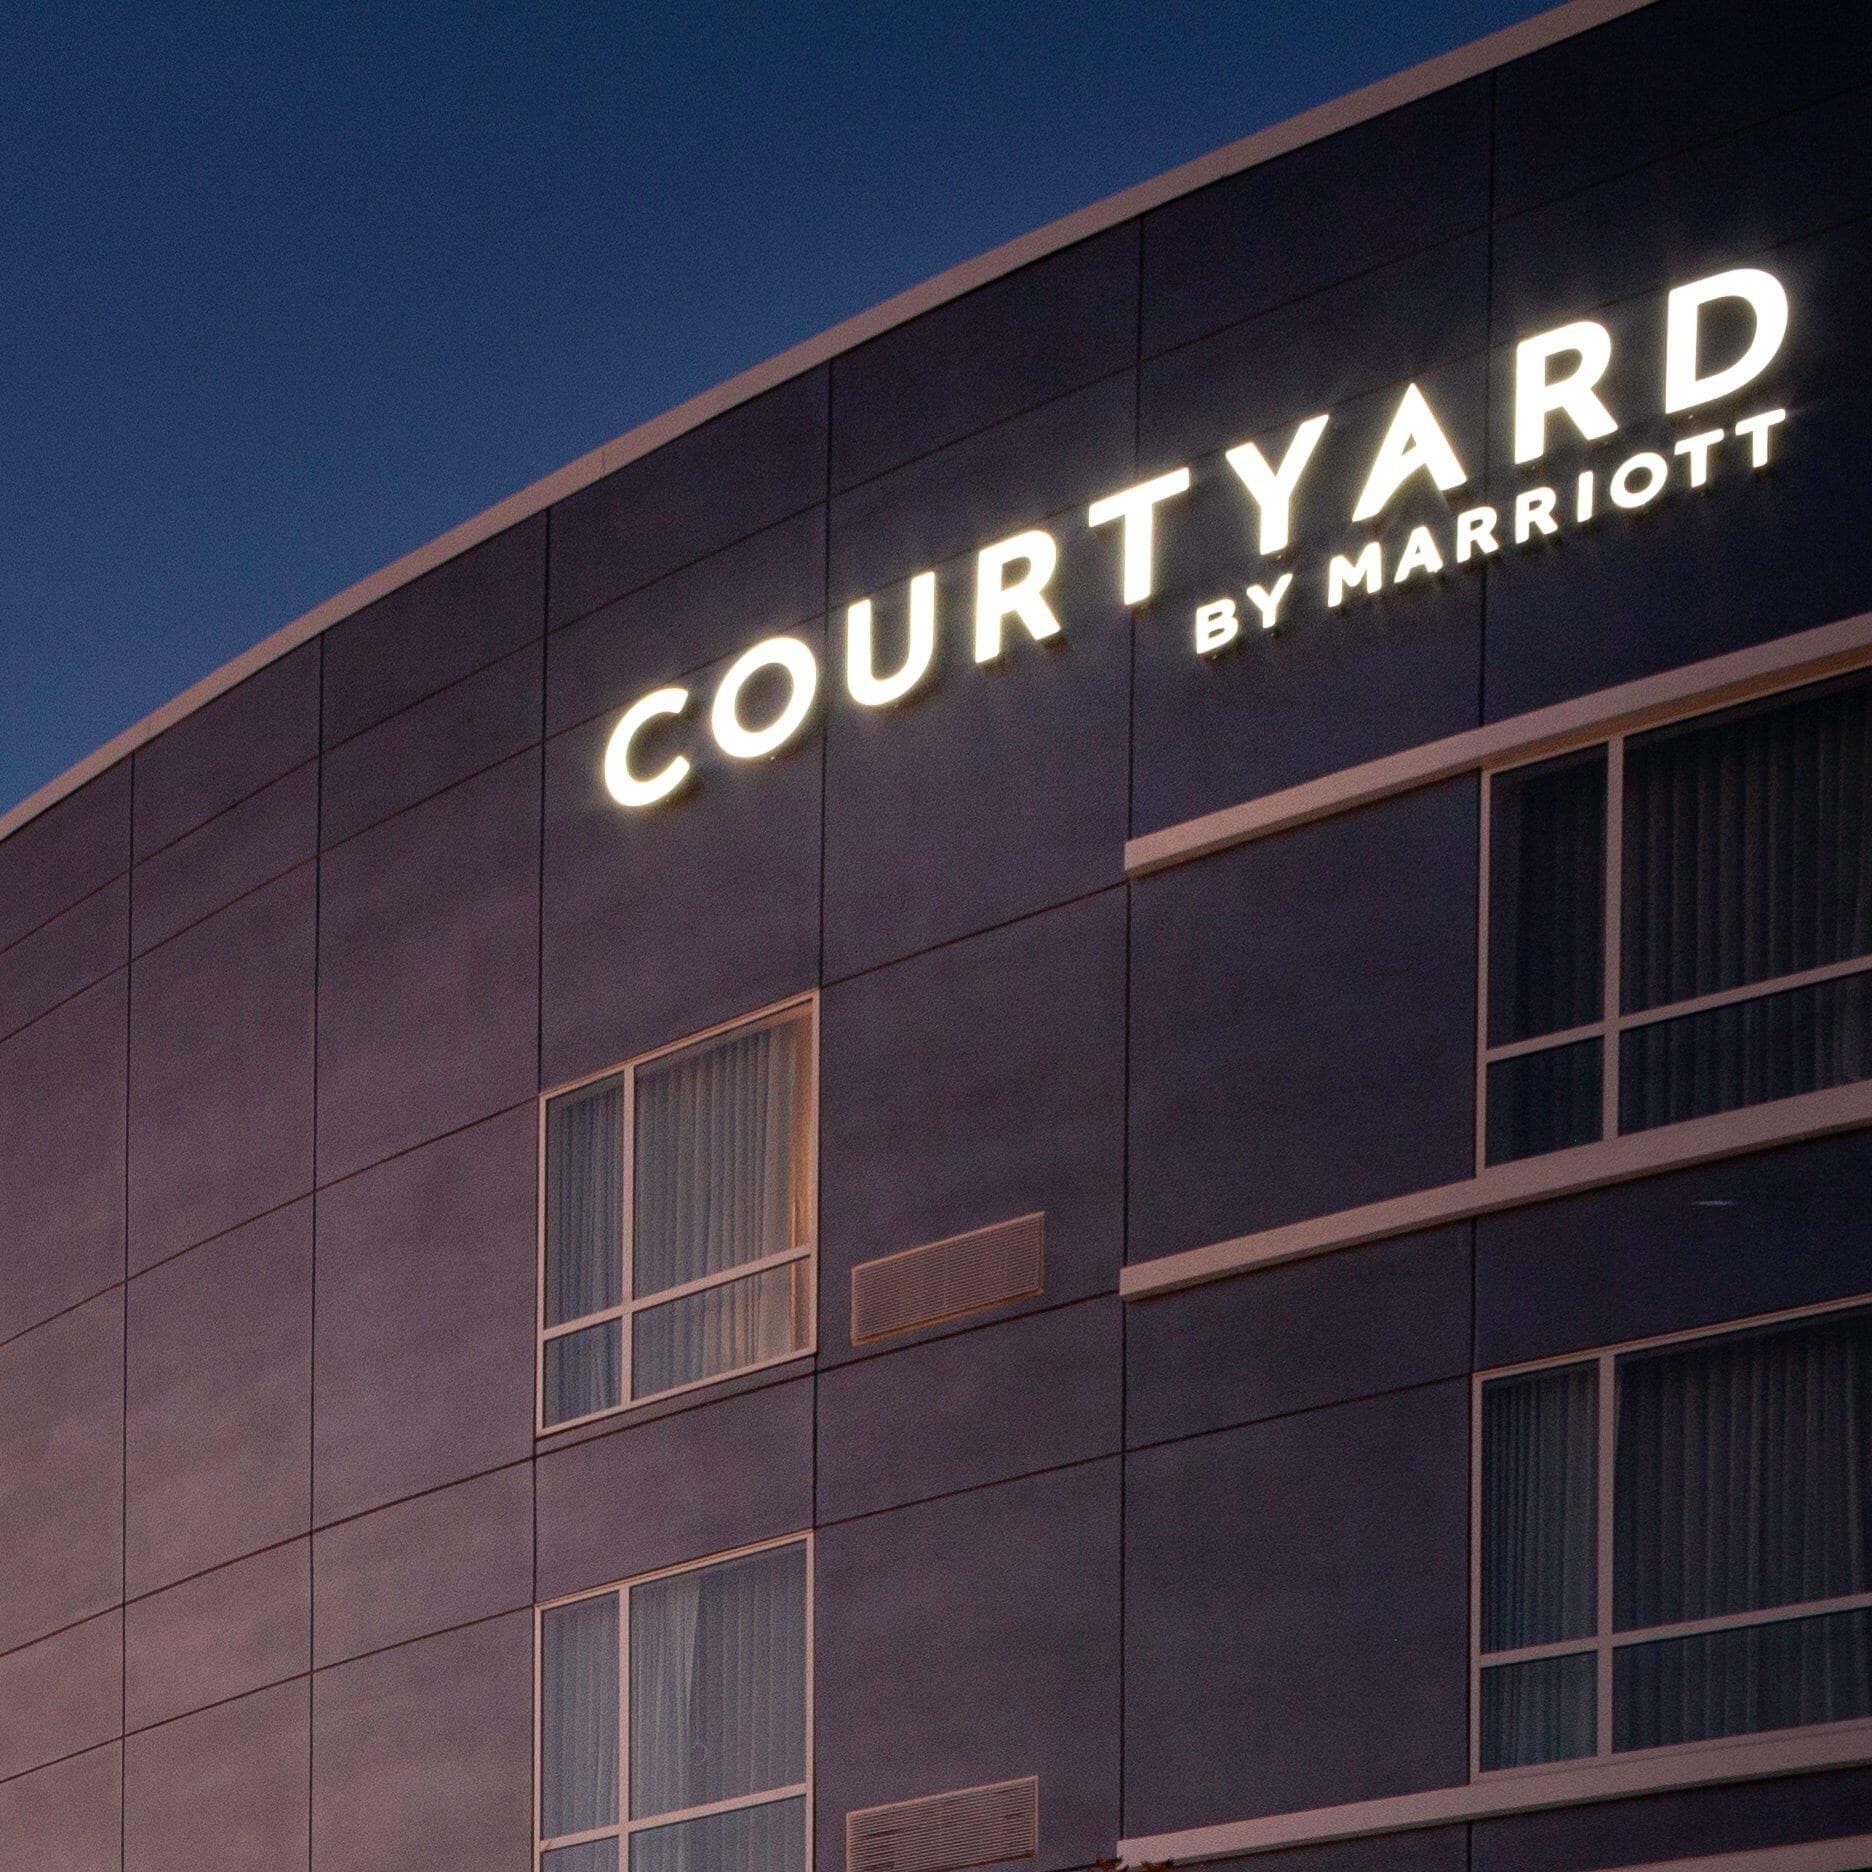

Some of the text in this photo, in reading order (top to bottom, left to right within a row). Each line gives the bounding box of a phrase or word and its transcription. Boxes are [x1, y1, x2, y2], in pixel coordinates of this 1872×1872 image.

[602, 266, 1790, 808] COURTYARD
[1194, 407, 1787, 655] BY MARRIOTT
